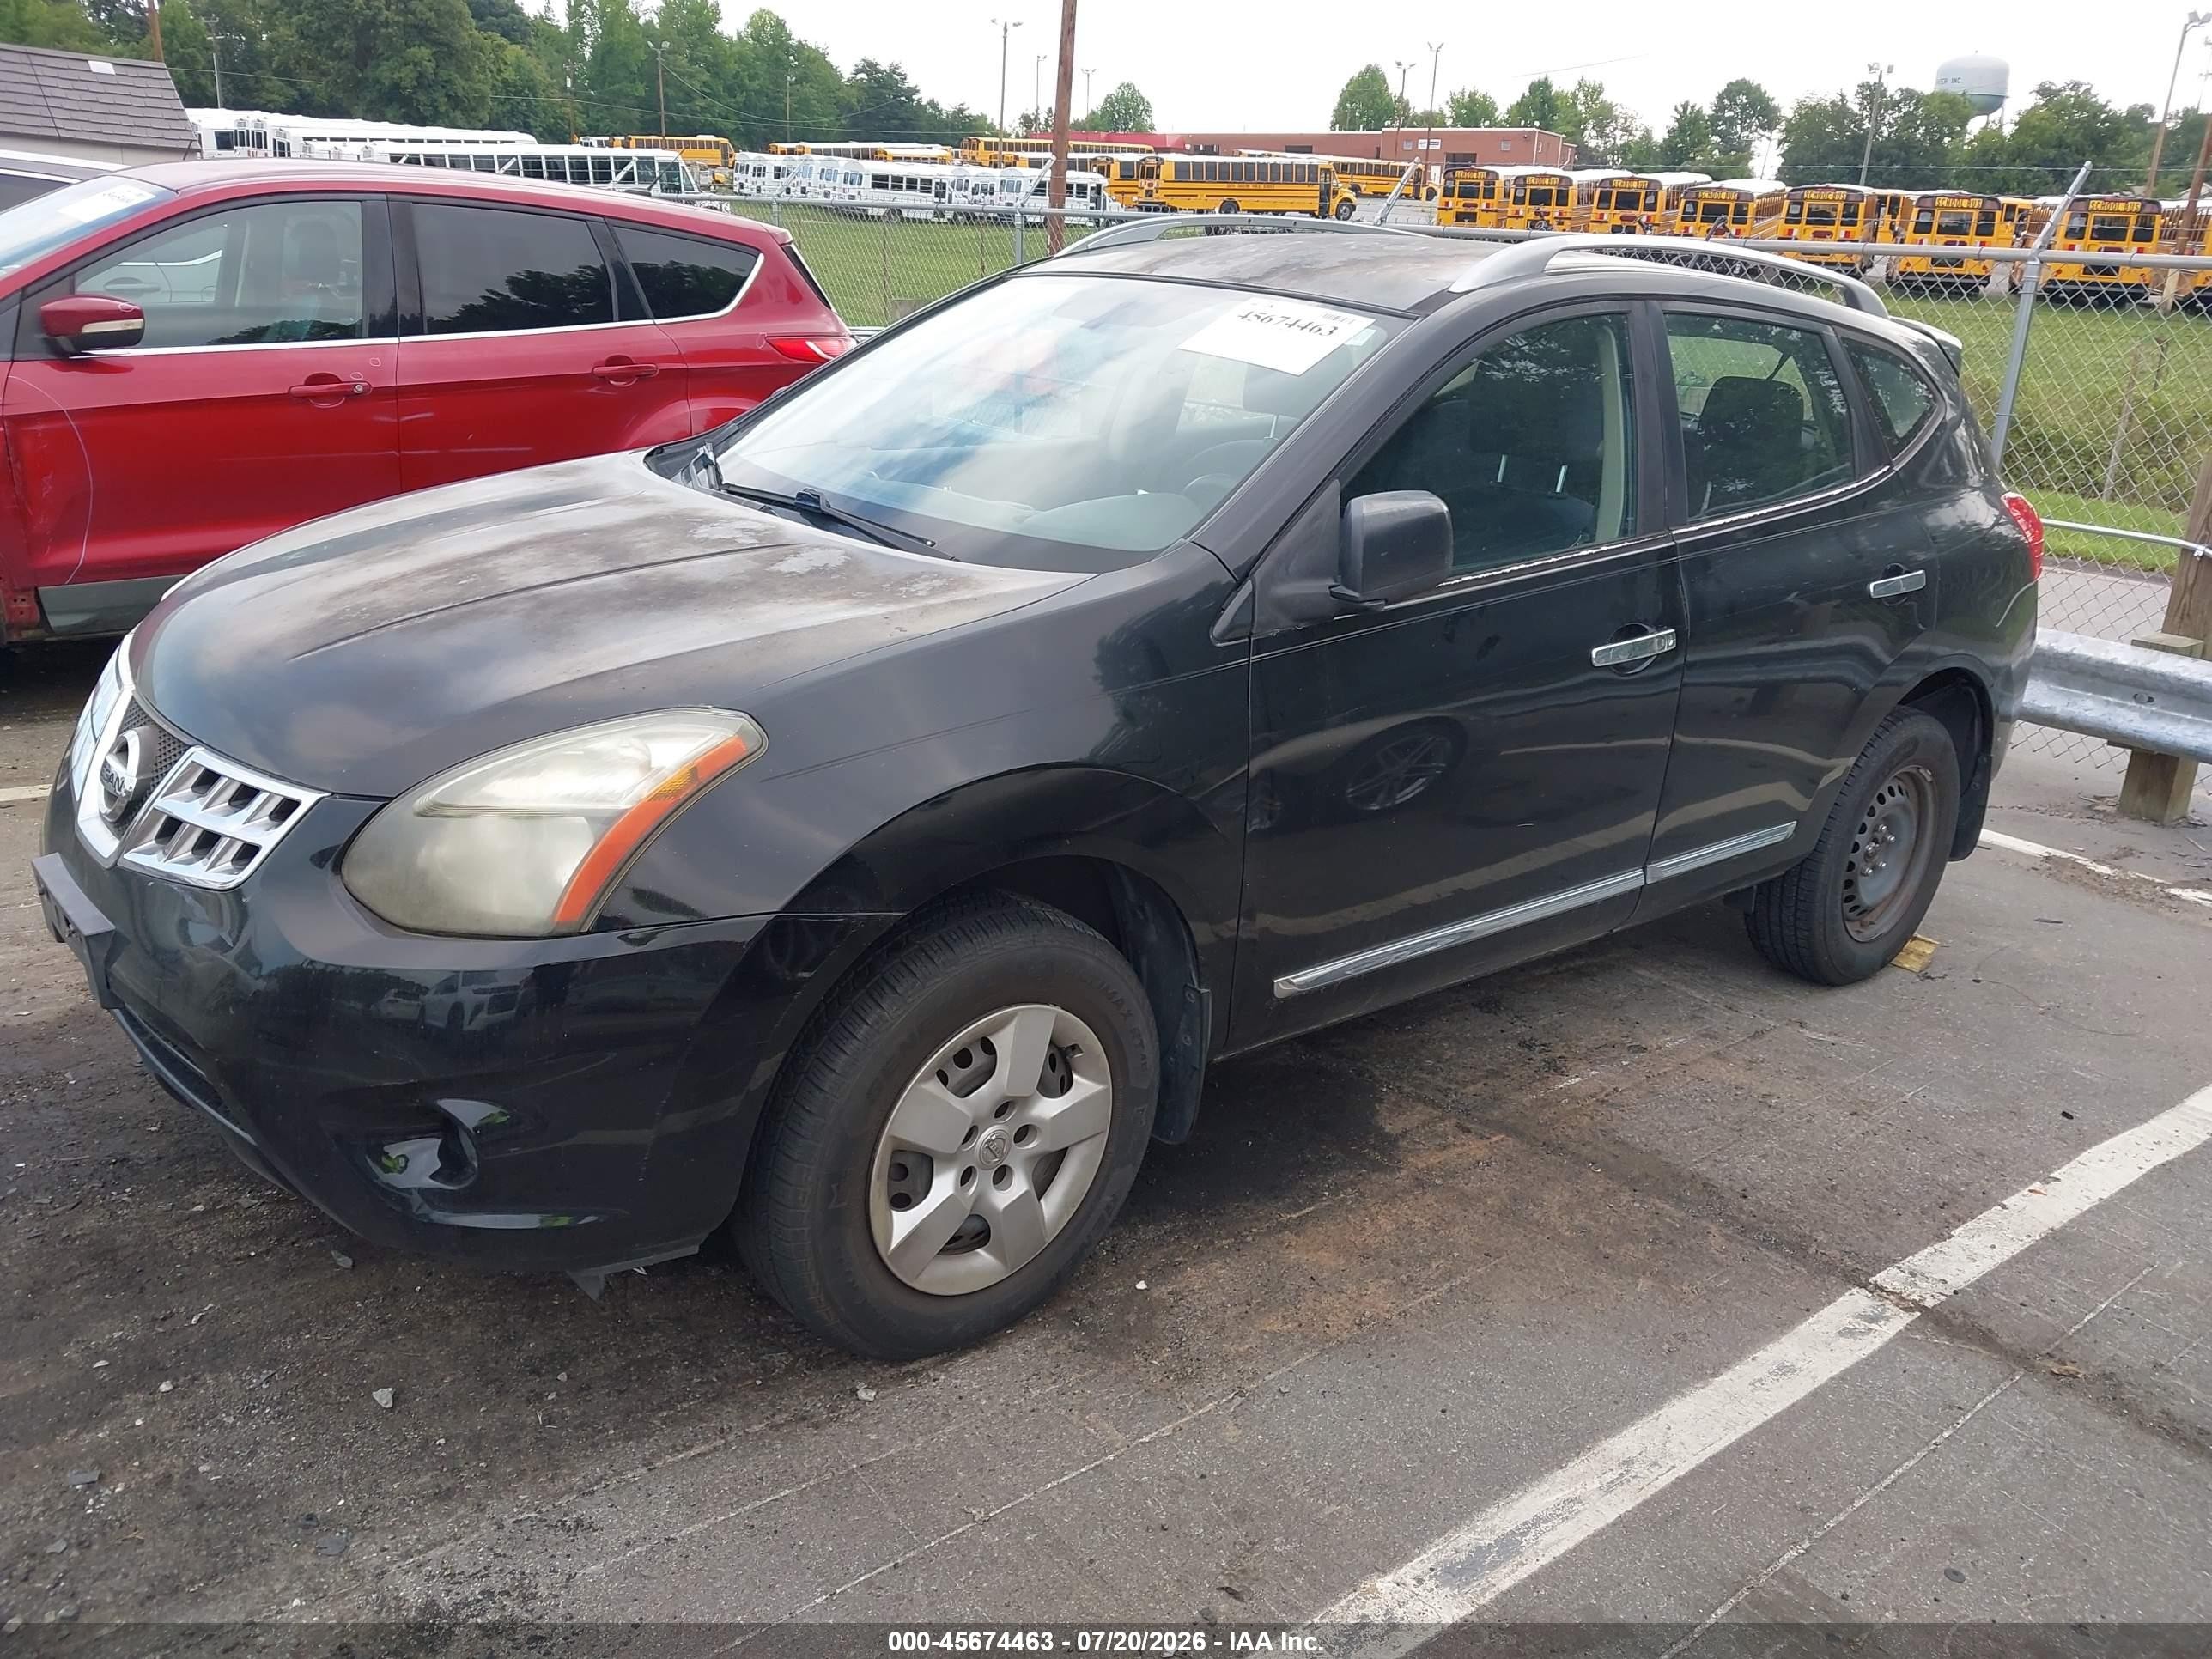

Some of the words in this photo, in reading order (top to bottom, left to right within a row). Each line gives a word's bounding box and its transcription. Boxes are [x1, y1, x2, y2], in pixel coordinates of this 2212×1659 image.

[1936, 198, 1965, 209] SCHOOL
[2090, 201, 2121, 210] SCHOOL
[1237, 311, 1339, 336] 45674463
